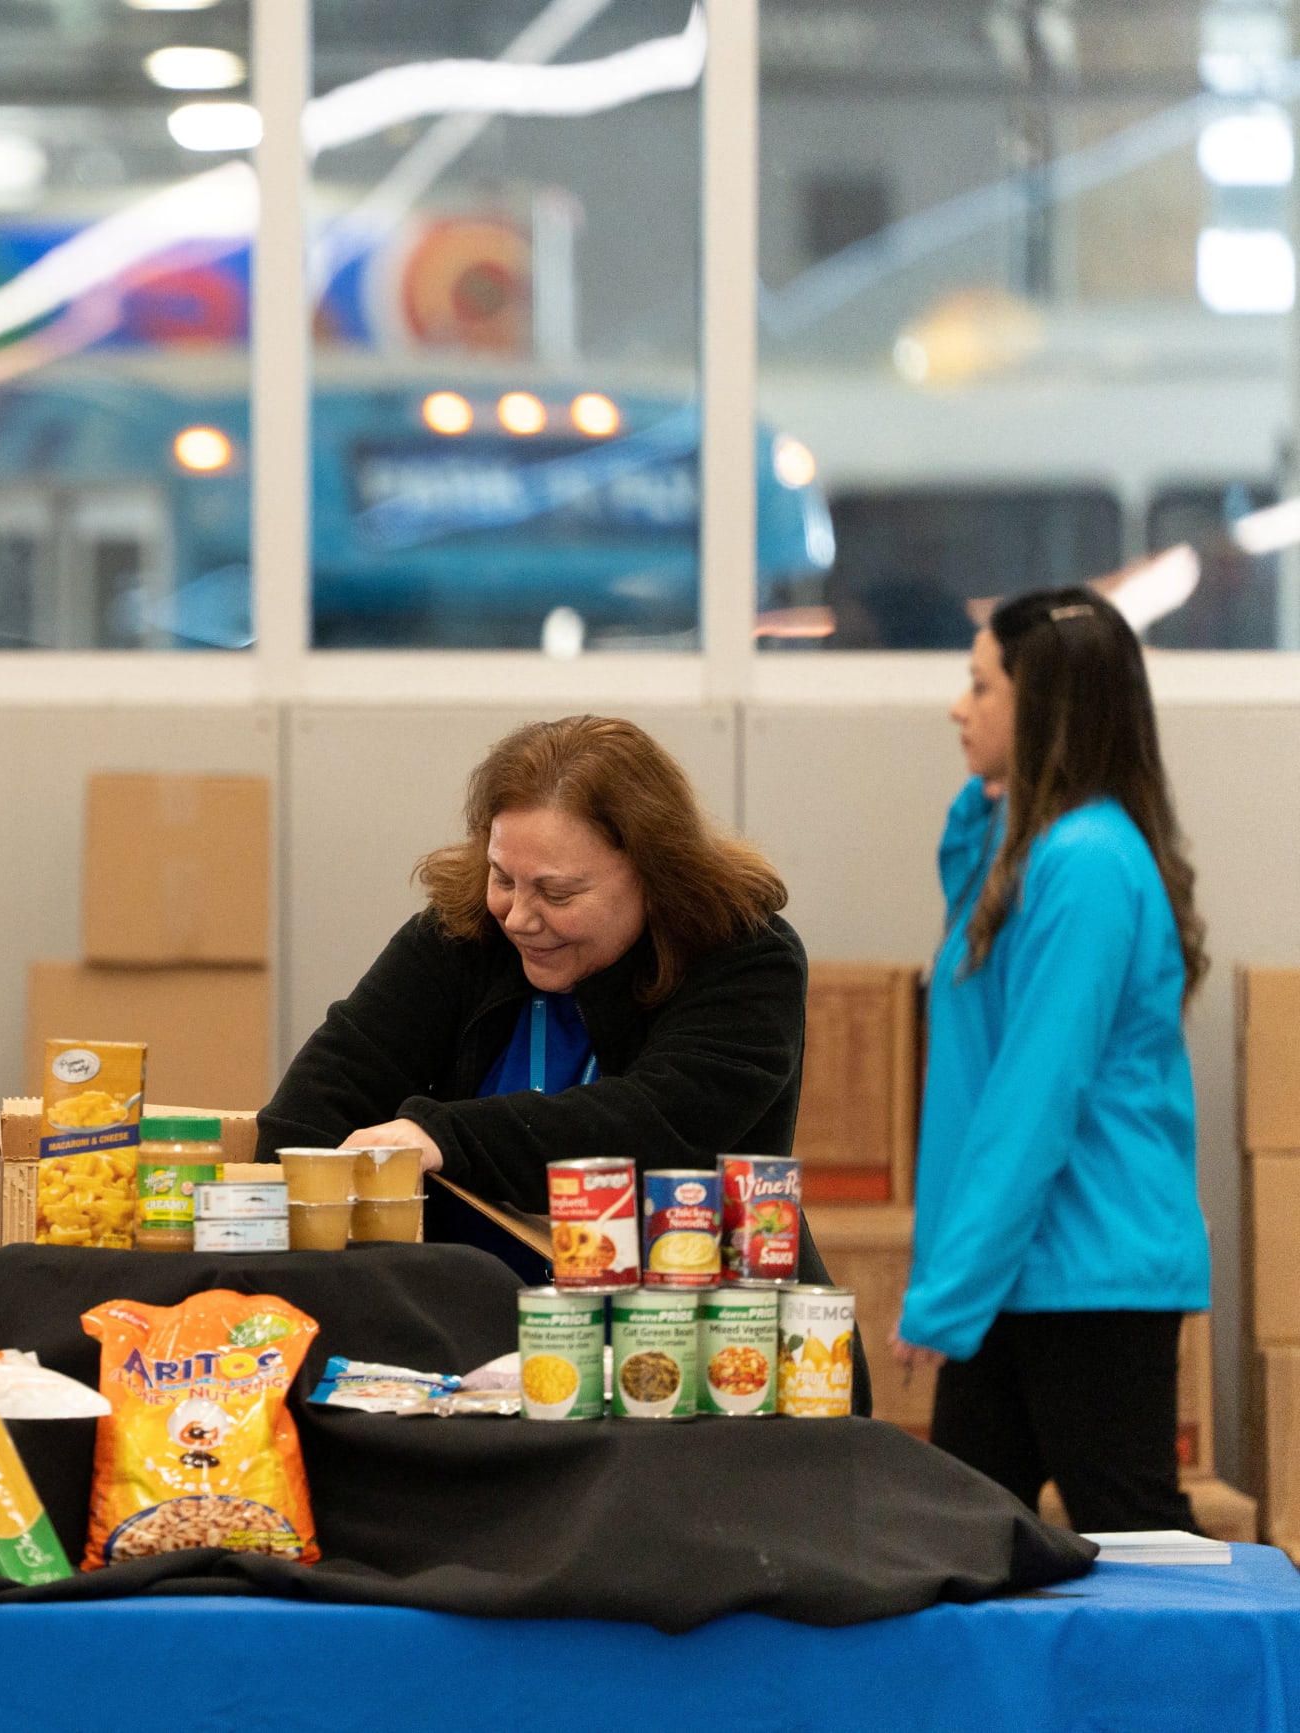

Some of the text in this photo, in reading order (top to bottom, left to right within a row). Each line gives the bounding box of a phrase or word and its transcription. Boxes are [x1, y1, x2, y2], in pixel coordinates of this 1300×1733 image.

[48, 1131, 129, 1152] MACARONI & CHEESE
[735, 1174, 776, 1202] Vine
[145, 1200, 189, 1211] CREAMY
[550, 1197, 589, 1210] paghetti
[666, 1207, 714, 1219] Chicken
[669, 1218, 710, 1229] Noodle
[760, 1248, 794, 1265] Sauce
[710, 1325, 740, 1335] Mixed
[796, 1372, 827, 1385] FRUIT
[189, 1386, 231, 1404] NUT
